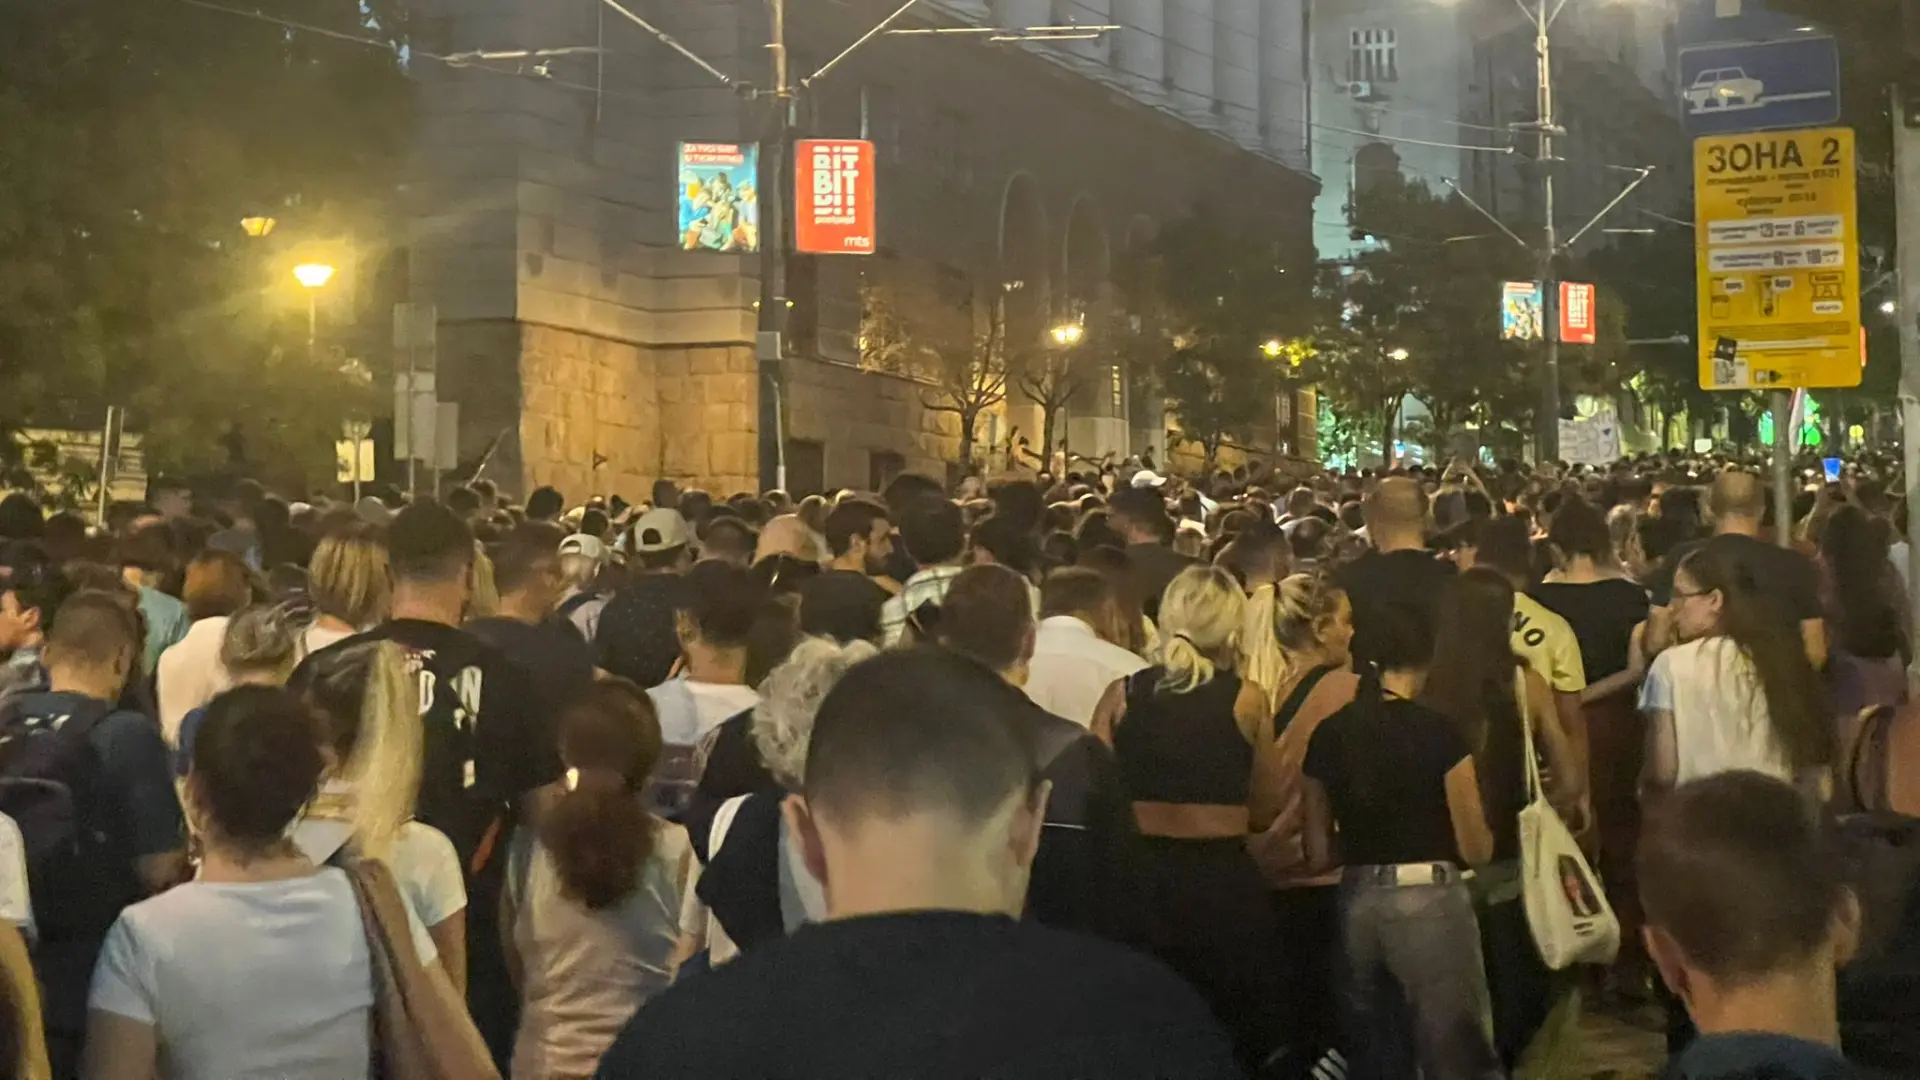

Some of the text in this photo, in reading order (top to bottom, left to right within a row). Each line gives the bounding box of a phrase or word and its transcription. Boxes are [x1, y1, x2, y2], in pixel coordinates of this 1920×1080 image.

[1707, 136, 1840, 173] ЗОНА 2
[813, 170, 859, 195] BIT
[844, 235, 870, 248] mts
